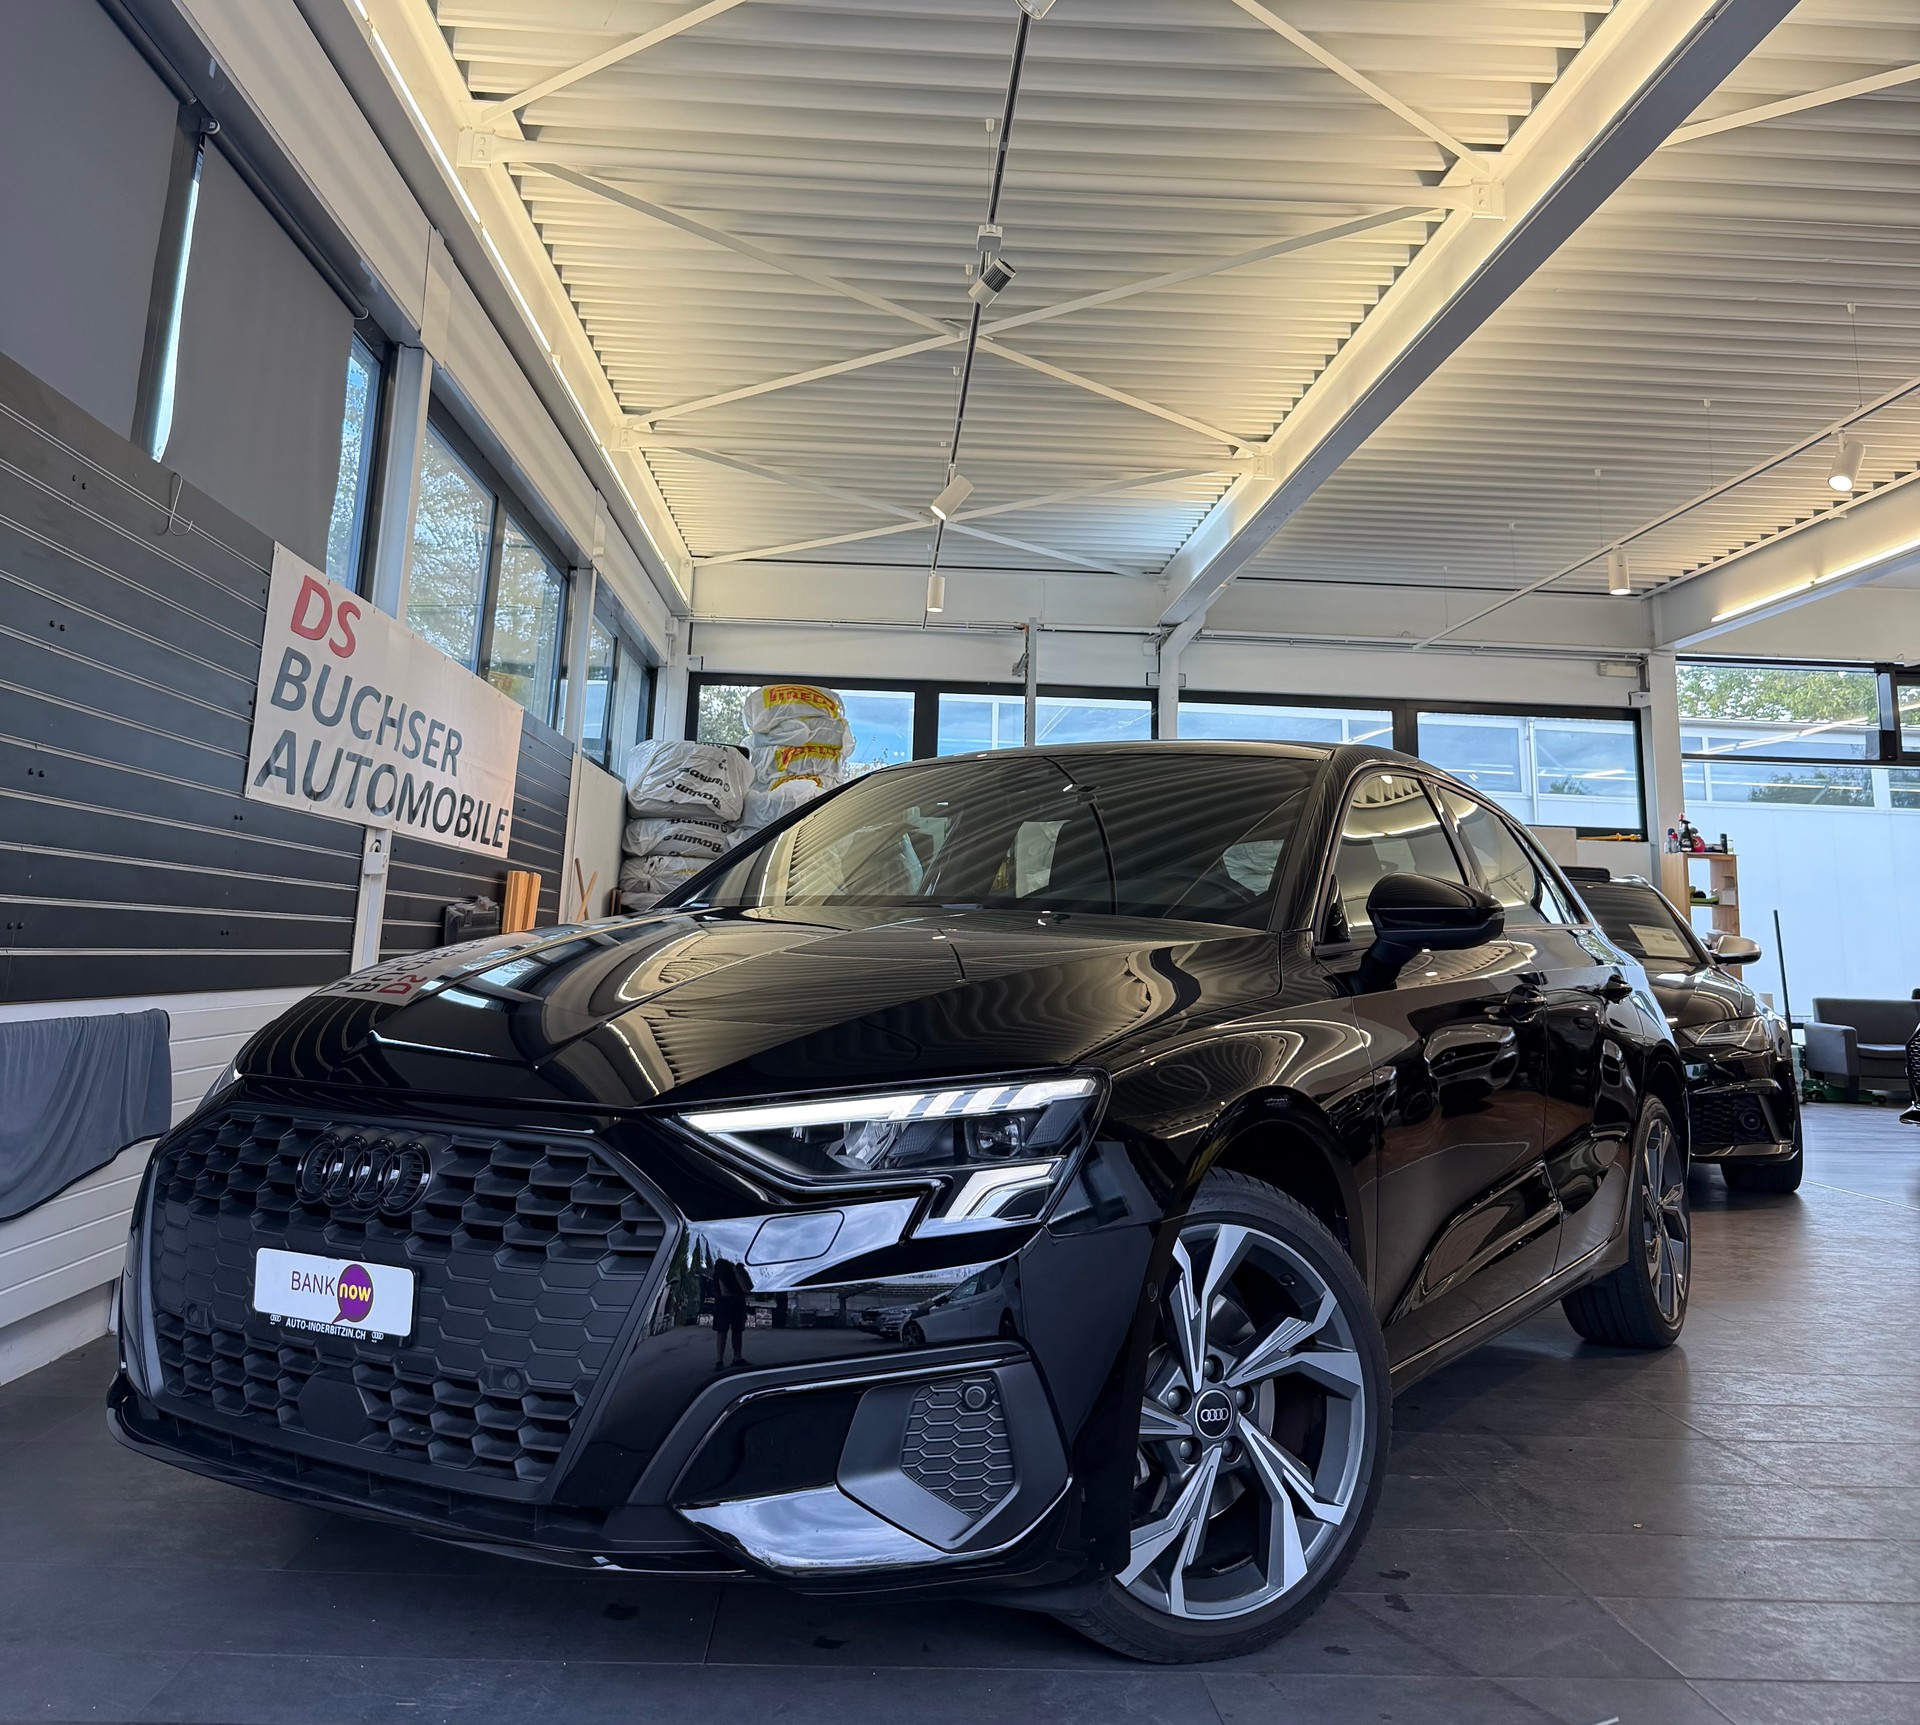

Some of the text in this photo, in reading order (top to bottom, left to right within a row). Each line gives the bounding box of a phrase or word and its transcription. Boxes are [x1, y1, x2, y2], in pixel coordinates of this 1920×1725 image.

[290, 575, 361, 658] DS
[270, 646, 463, 777] BUCHSER
[253, 729, 510, 848] AUTOMOBILE
[291, 1270, 372, 1302] BANK now
[285, 1317, 367, 1341] AUTO-INDERBITZIN.CH
